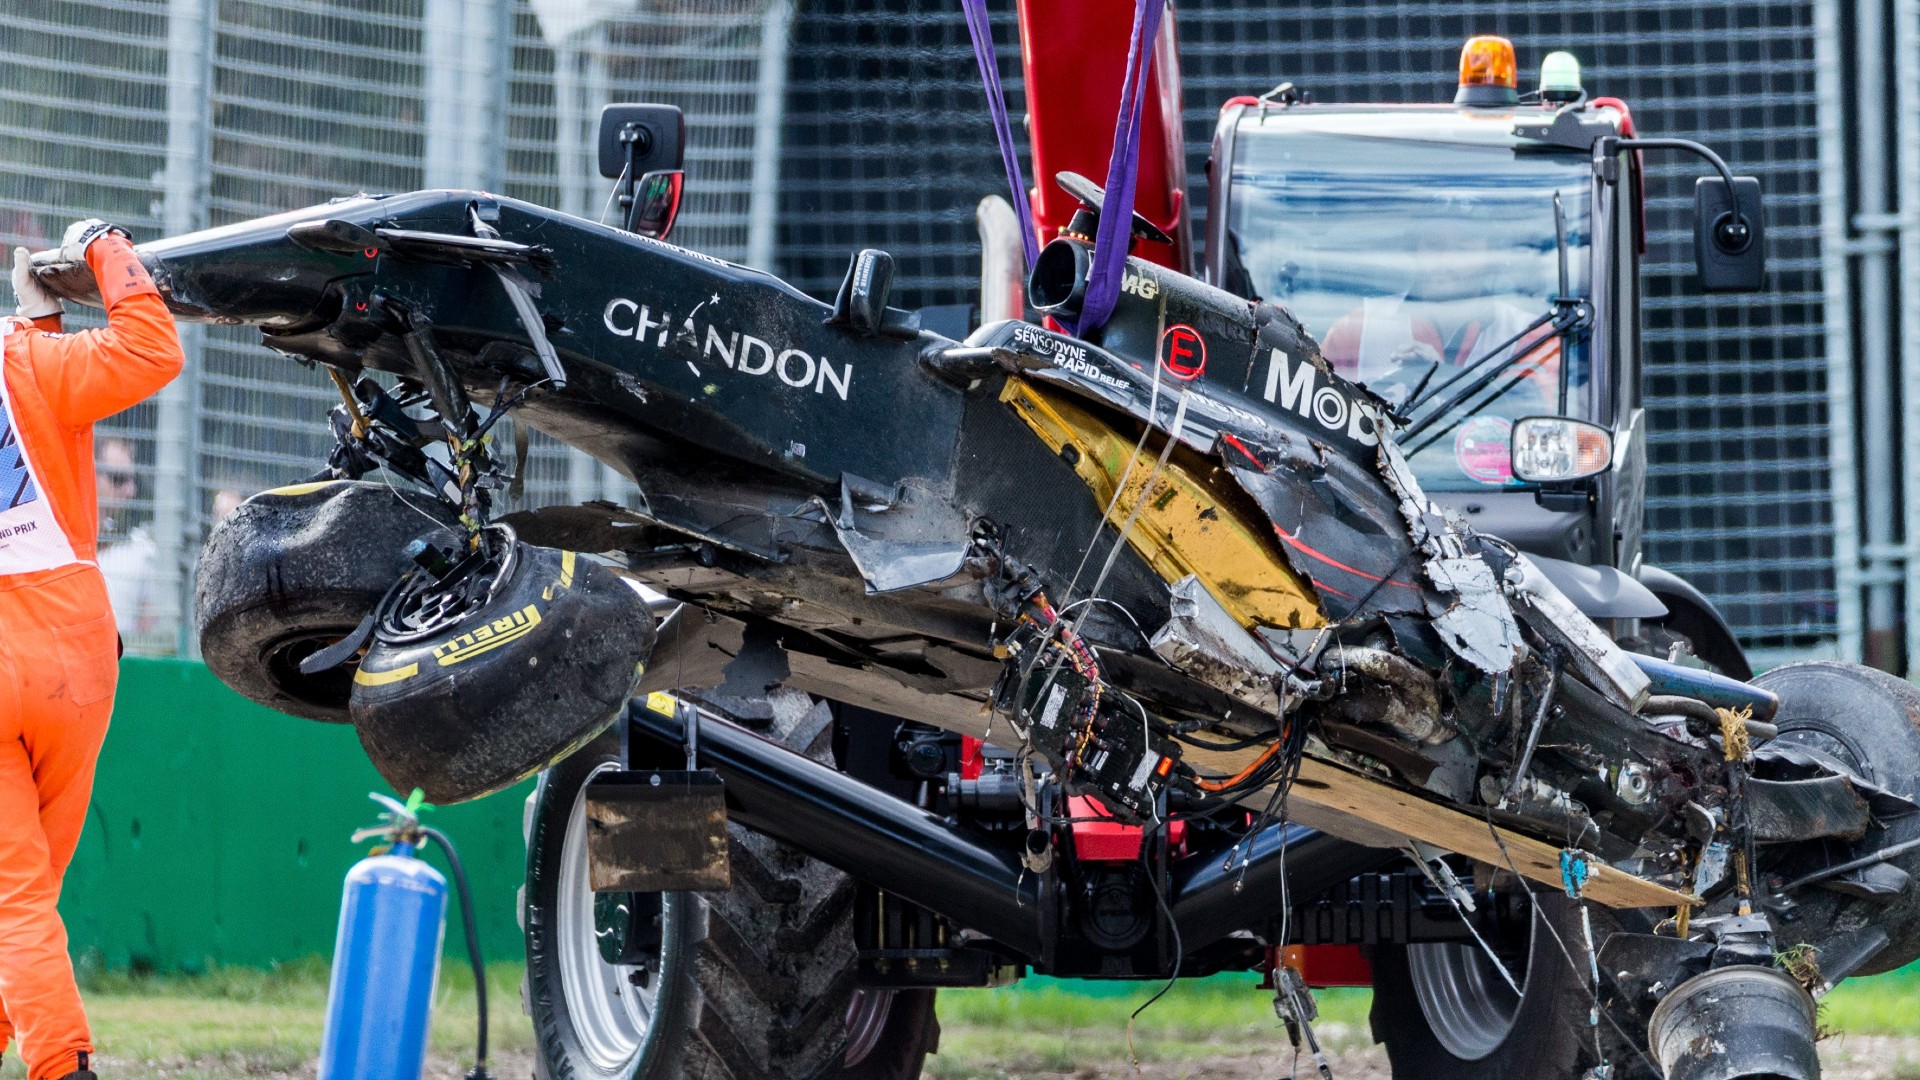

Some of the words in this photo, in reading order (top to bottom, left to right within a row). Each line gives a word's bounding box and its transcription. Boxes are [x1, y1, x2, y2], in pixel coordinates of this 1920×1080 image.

[1121, 266, 1156, 300] MG
[603, 297, 853, 401] CHANDON
[1014, 328, 1087, 361] SENSODYNE
[1053, 352, 1100, 379] RAPID
[1100, 374, 1130, 389] RELIEF
[13, 520, 38, 535] PRIX
[432, 604, 542, 667] PIRELLI
